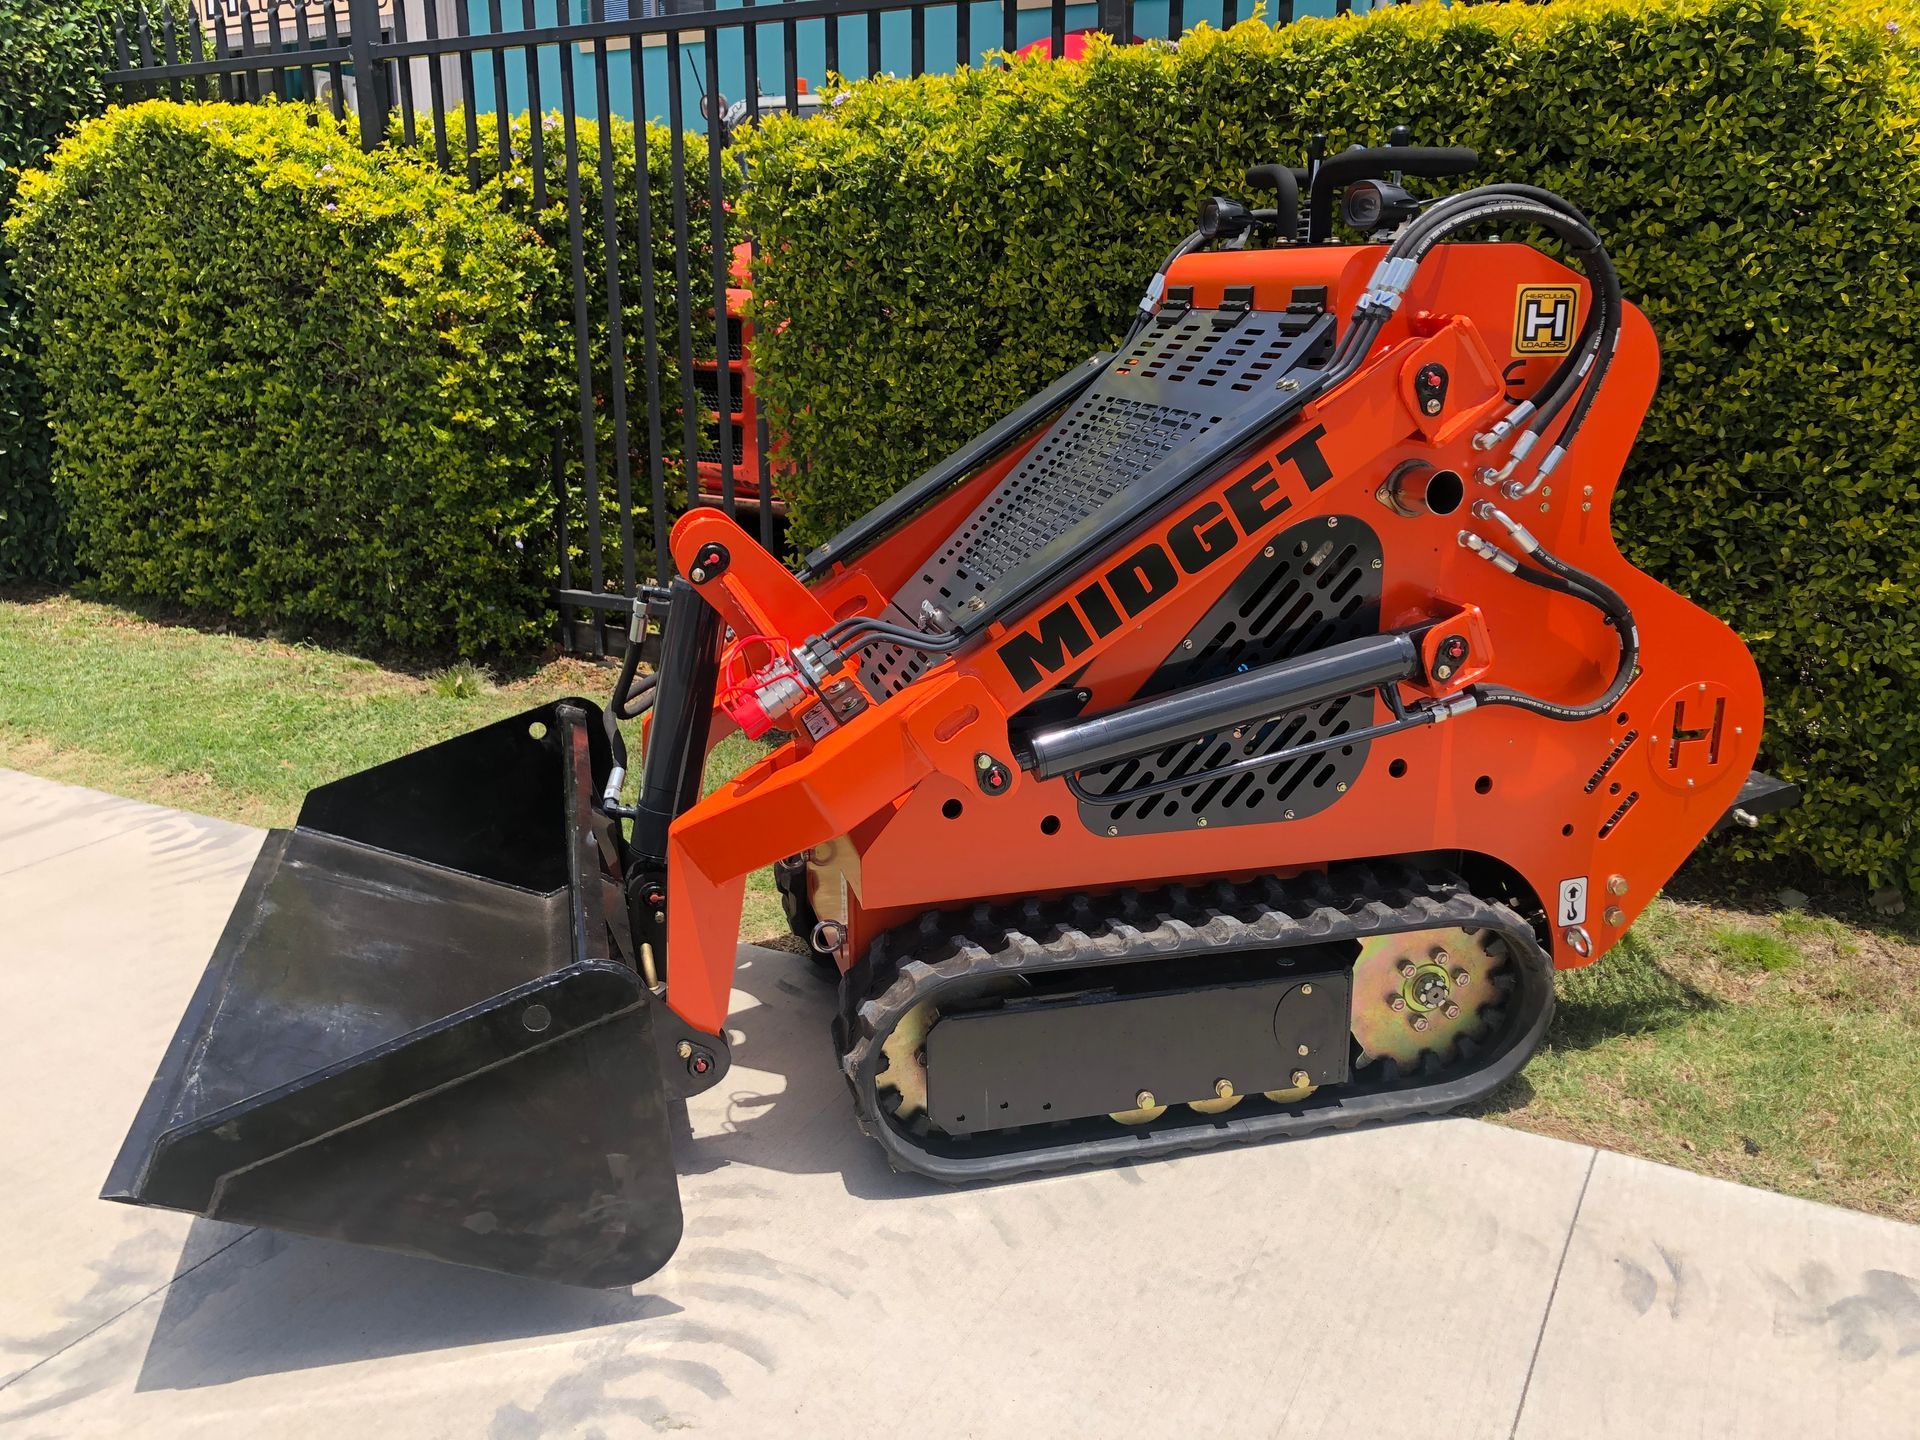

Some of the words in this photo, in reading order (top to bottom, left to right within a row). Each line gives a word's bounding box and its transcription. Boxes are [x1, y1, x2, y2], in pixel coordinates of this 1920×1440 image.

[1523, 300, 1570, 341] H
[1520, 340, 1568, 349] LOADERS
[996, 423, 1333, 694] MIDGET
